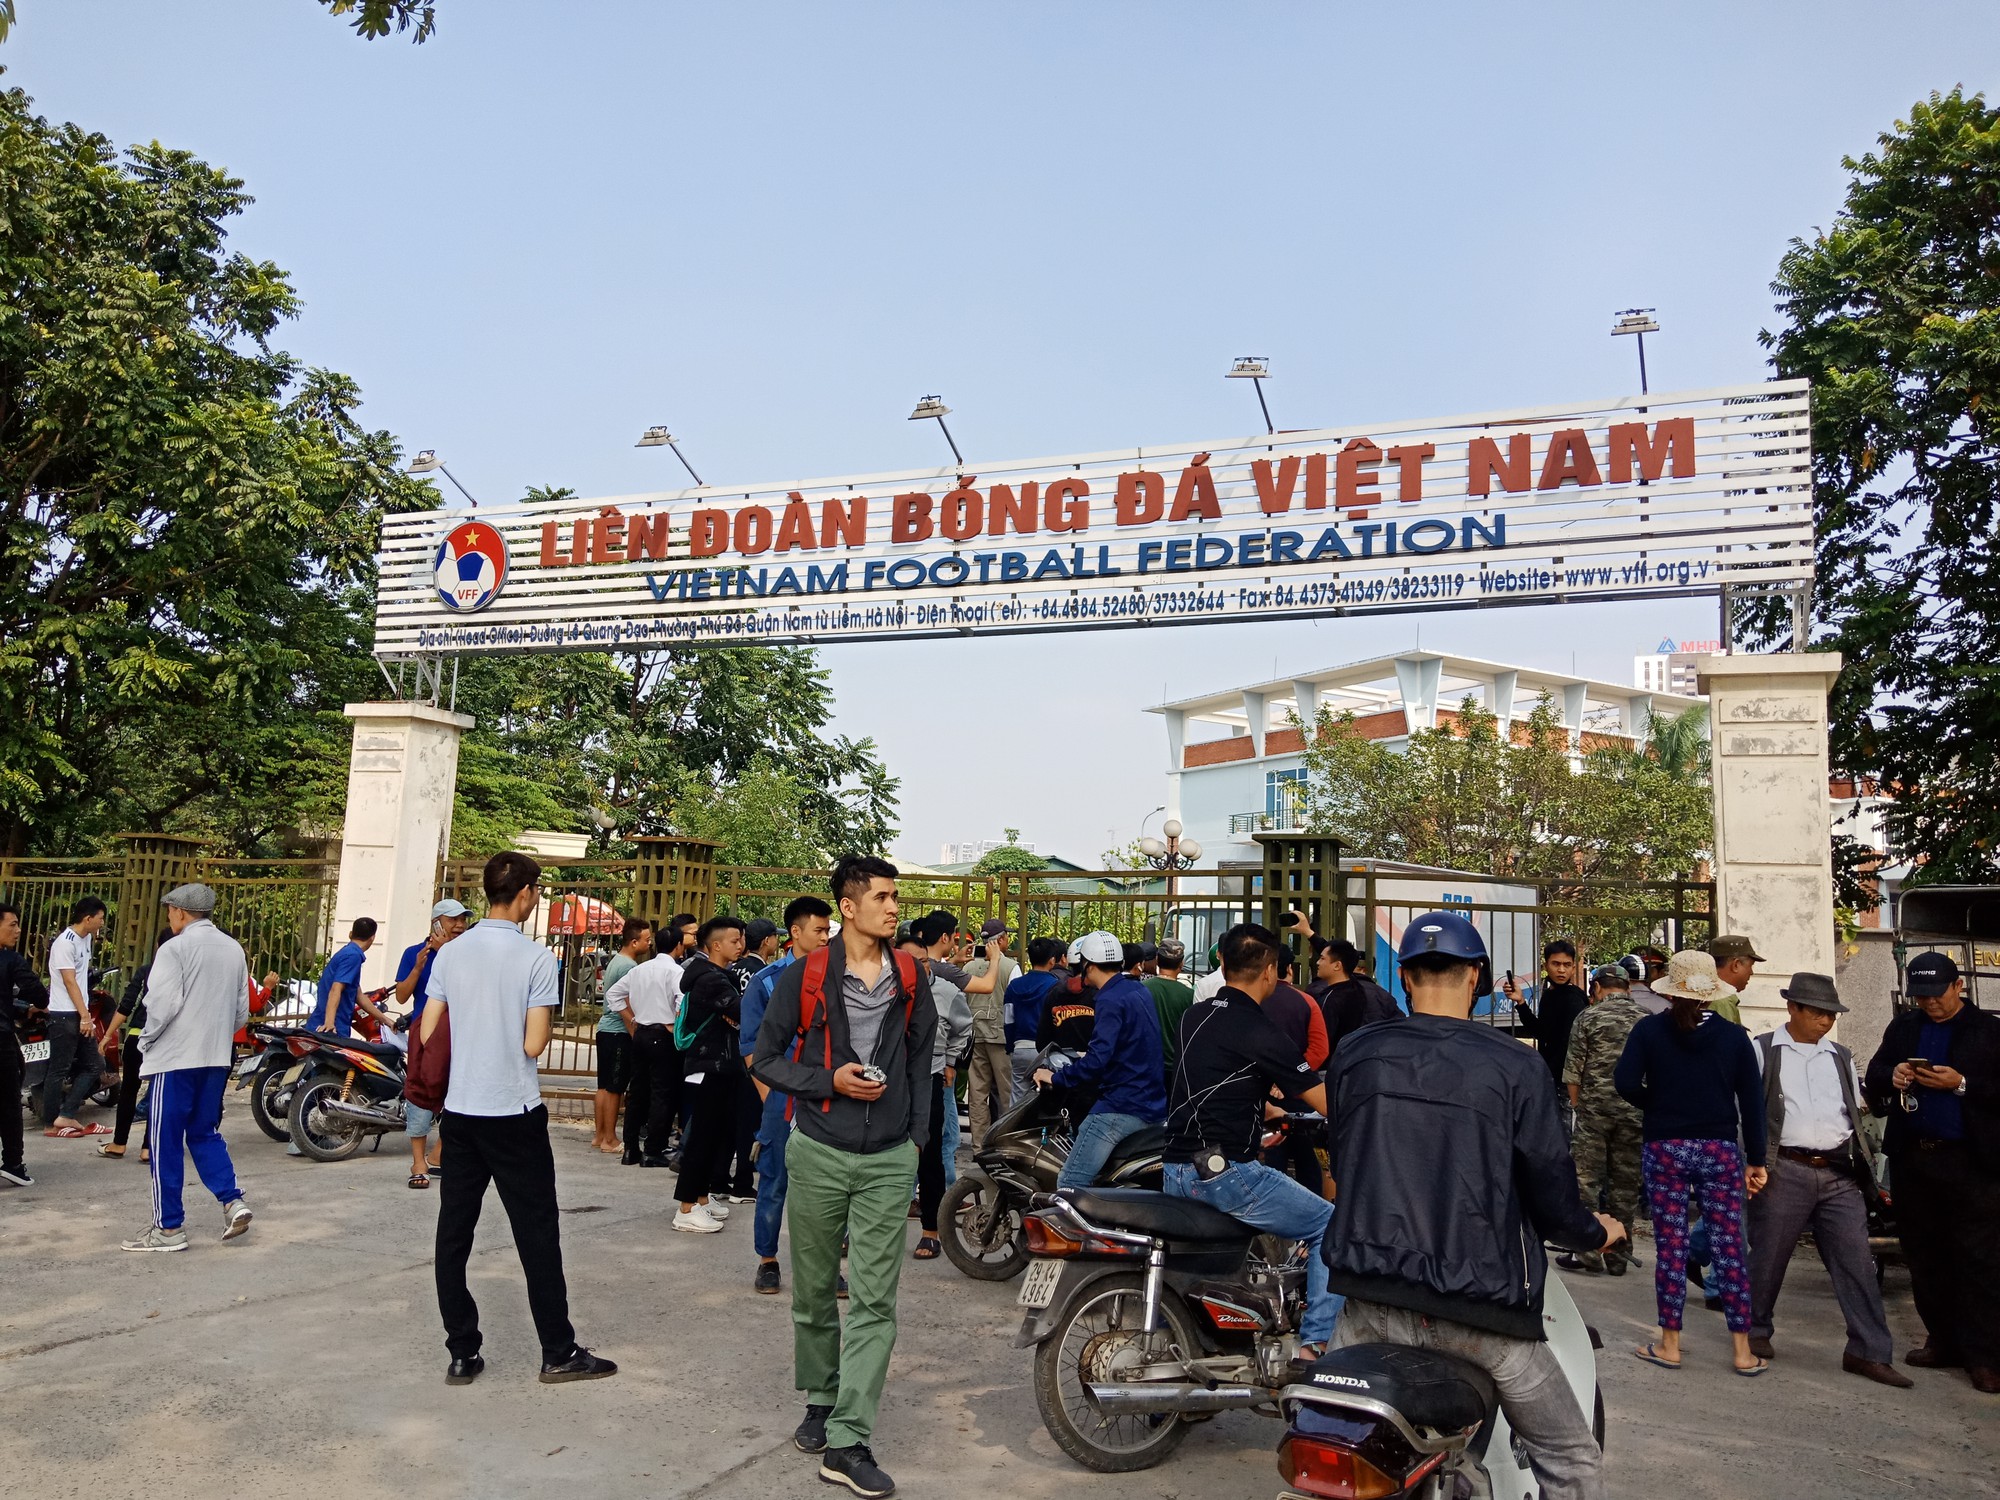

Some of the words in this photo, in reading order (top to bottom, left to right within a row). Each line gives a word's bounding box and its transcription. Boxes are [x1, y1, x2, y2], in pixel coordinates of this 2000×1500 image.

[540, 506, 669, 567] LIÊN
[689, 491, 868, 557] ĐOÀN
[891, 475, 1090, 544] BÓNG
[1114, 453, 1222, 526] ĐÁ
[1251, 437, 1435, 520] VIỆT
[1468, 416, 1696, 497] NAM
[647, 564, 848, 601] VIETNAM
[864, 545, 1121, 589] FOOTBALL
[1138, 513, 1506, 572] FEDERATION
[457, 589, 478, 600] VFF
[567, 623, 579, 641] Lê
[583, 623, 621, 643] Quang
[701, 616, 721, 635] Phú
[783, 613, 812, 632] Nam
[886, 605, 908, 629] Nội
[1681, 640, 1720, 652] MHD
[1054, 1006, 1095, 1027] SUPERMAN
[1022, 1283, 1050, 1304] 4964
[1313, 1373, 1370, 1389] HONDA
